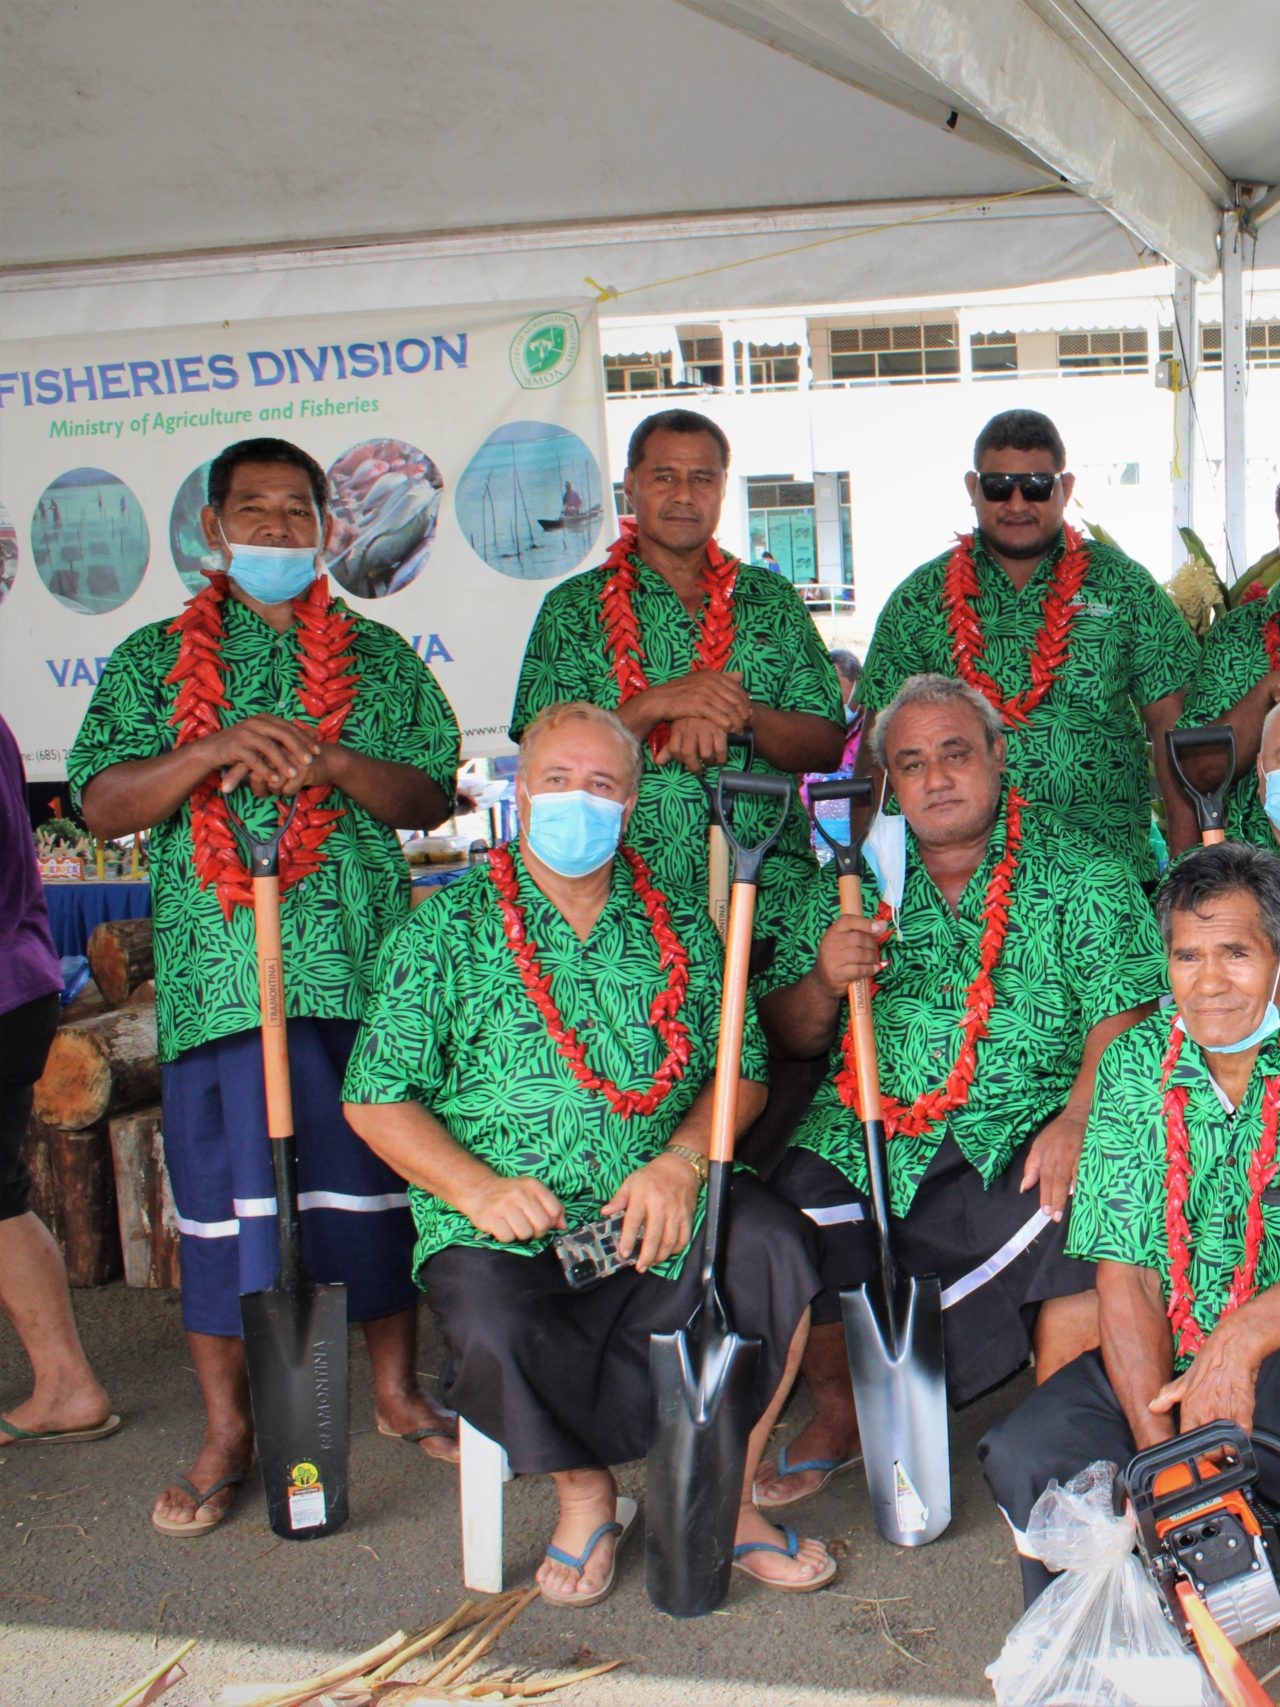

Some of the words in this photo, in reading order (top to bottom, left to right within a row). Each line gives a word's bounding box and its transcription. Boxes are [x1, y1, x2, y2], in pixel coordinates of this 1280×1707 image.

[0, 354, 239, 408] FISHERIES
[247, 333, 468, 387] DIVISION
[49, 419, 124, 438] Ministry
[130, 413, 150, 435] of
[152, 407, 253, 434] Agriculture
[259, 401, 294, 422] and
[300, 396, 380, 418] Fisheries
[268, 964, 280, 1021] TRAMONTINA
[313, 1341, 333, 1449] TRAMONTINA
